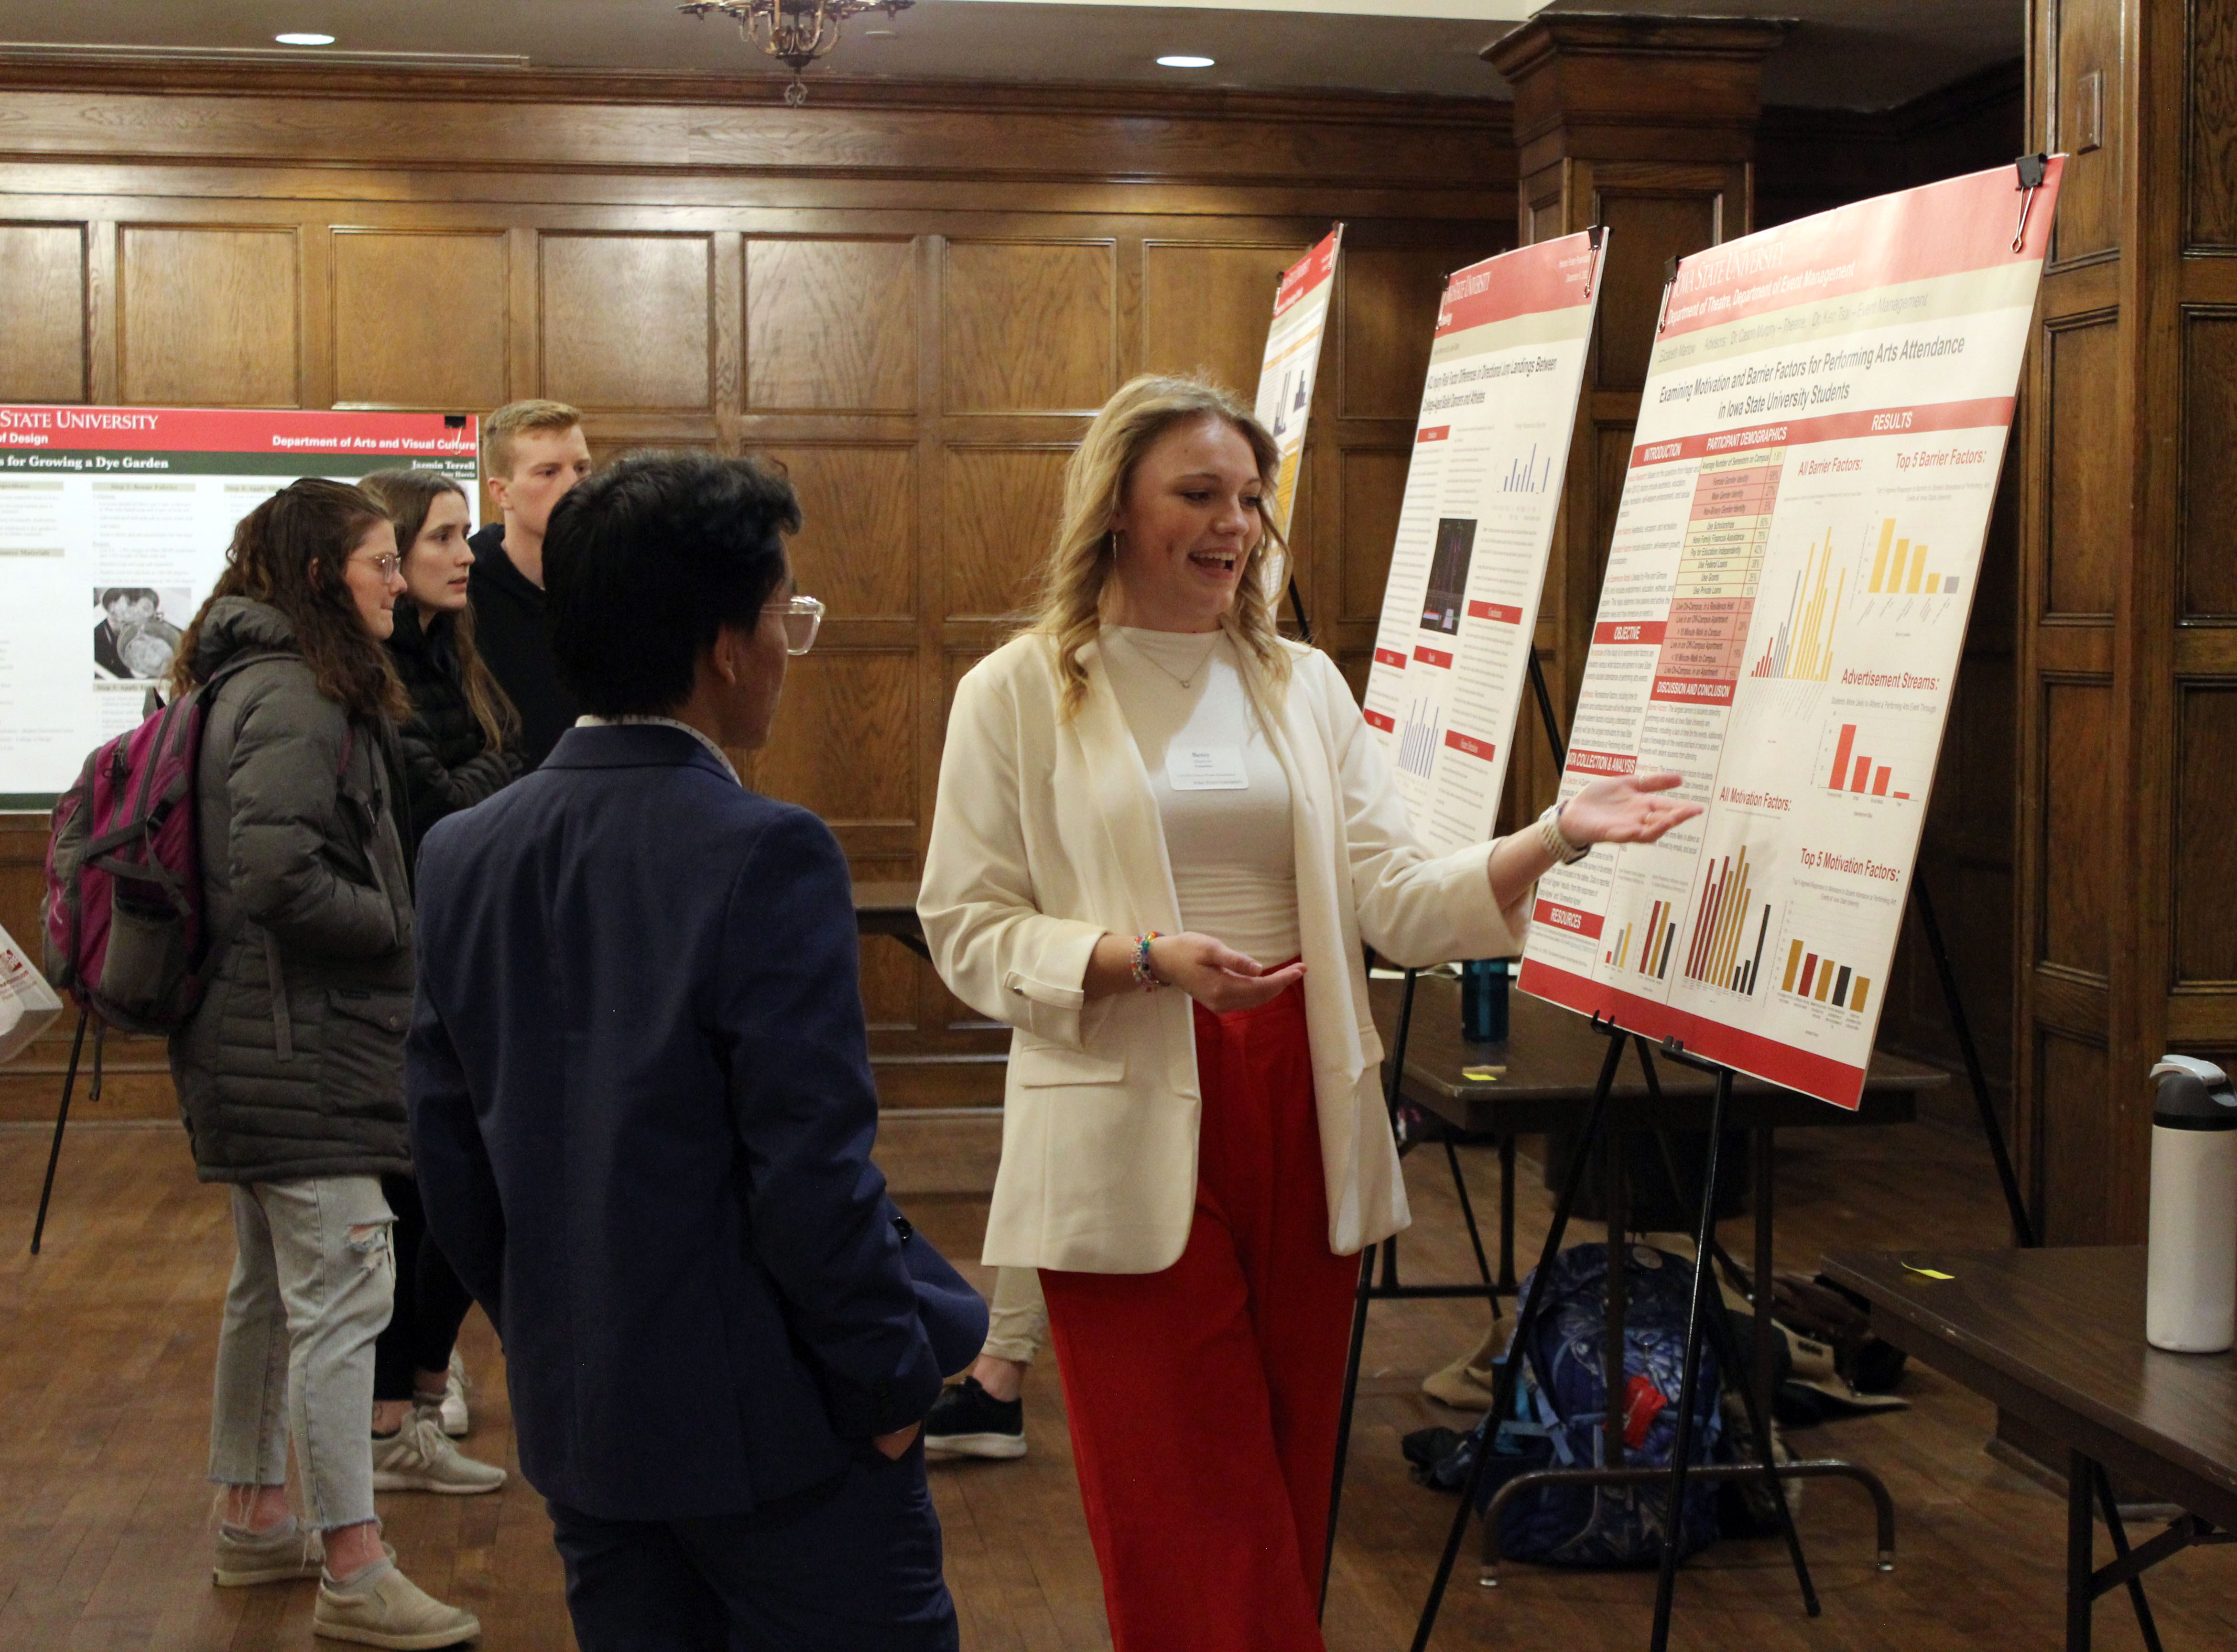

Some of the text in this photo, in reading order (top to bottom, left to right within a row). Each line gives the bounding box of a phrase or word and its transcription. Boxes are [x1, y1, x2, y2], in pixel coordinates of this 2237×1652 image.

[1695, 260, 1726, 291] STATE
[1726, 240, 1787, 282] UNIVERSITY
[1667, 260, 1856, 325] Department of Theatre, Department of Event Management
[1857, 301, 1879, 318] Event
[1877, 293, 1929, 316] Management
[1510, 356, 1557, 377] Landings Between
[1659, 336, 1966, 405] Examining Motivation and Barrier Factors for Performing Arts Attendance
[1718, 380, 1851, 421] in Iowa State University Students
[0, 410, 159, 430] STATE UNIVERSITY
[1871, 412, 1913, 431] RESULTS
[10, 433, 49, 446] Design
[272, 435, 477, 451] Department of Arts and Visual Culture
[1706, 426, 1788, 451] PARTICIPANT DEMOGRAPHICS
[1643, 443, 1683, 462] INTRODUCTION
[1702, 461, 1715, 470] Average
[1733, 456, 1749, 465] Semesters
[1754, 454, 1770, 463] Campus
[1896, 448, 1987, 472] Top 5 Barrier Factors:
[7, 455, 27, 467] for
[29, 456, 83, 471] Growing
[85, 457, 94, 467] a
[95, 456, 120, 471] Dye
[122, 456, 169, 469] Garden
[412, 459, 475, 471] Jazmin Terrell
[1798, 457, 1863, 476] All Barrier Factors:
[110, 483, 124, 491] Step
[1701, 535, 1711, 544] Family
[1718, 547, 1741, 555] Independently
[1614, 626, 1641, 640] OBJECTIVE
[1656, 681, 1731, 698] DISCUSSION AND CONCLUSION
[1841, 668, 1940, 691] Advertisement Streams:
[1576, 753, 1636, 774] COLLECTION & ANALYSIS
[1719, 786, 1792, 812] All Motivation Factors:
[1801, 848, 1900, 882] Top 5 Motivation Factors:
[1551, 907, 1583, 930] RESOURCES
